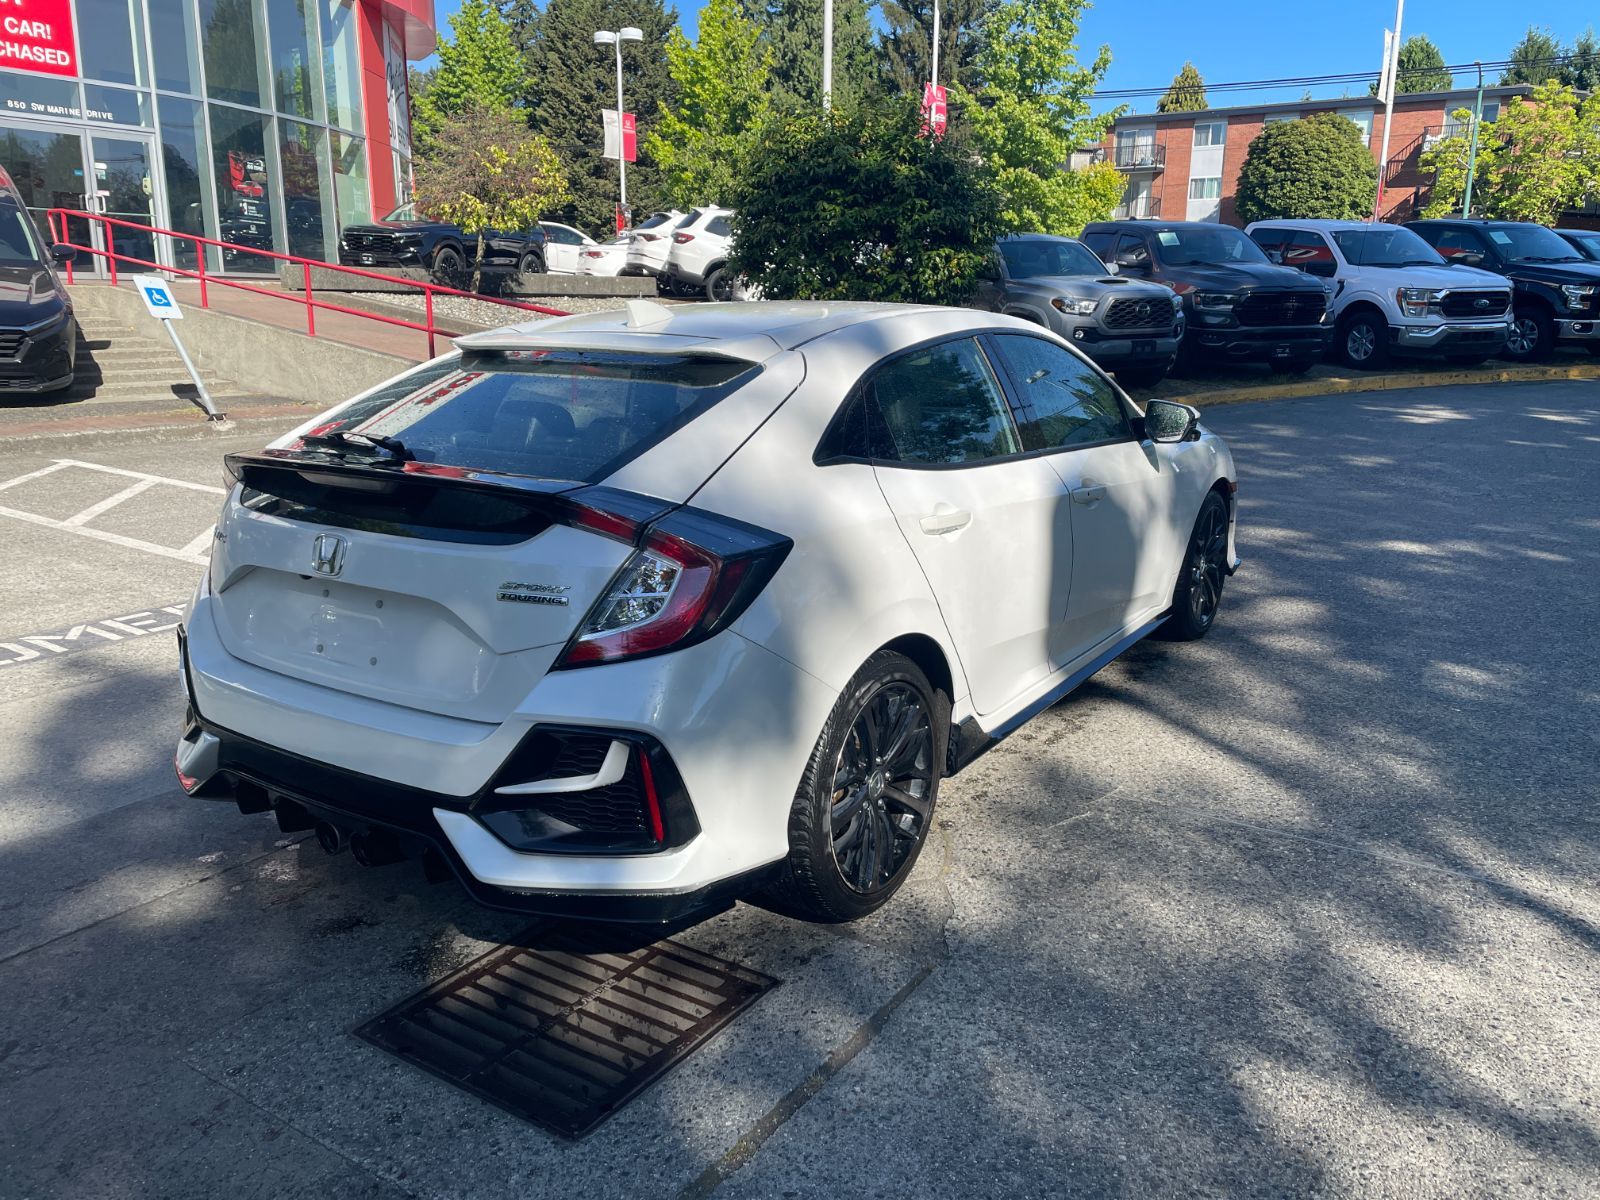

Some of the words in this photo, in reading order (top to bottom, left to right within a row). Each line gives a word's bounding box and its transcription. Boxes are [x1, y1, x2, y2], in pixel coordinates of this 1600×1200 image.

[4, 16, 52, 40] CAR!
[7, 99, 26, 110] 850
[31, 102, 45, 112] SW
[47, 105, 81, 116] MARINE
[86, 109, 114, 120] DRIVE
[498, 581, 571, 593] SPORT
[498, 593, 565, 605] TOURING
